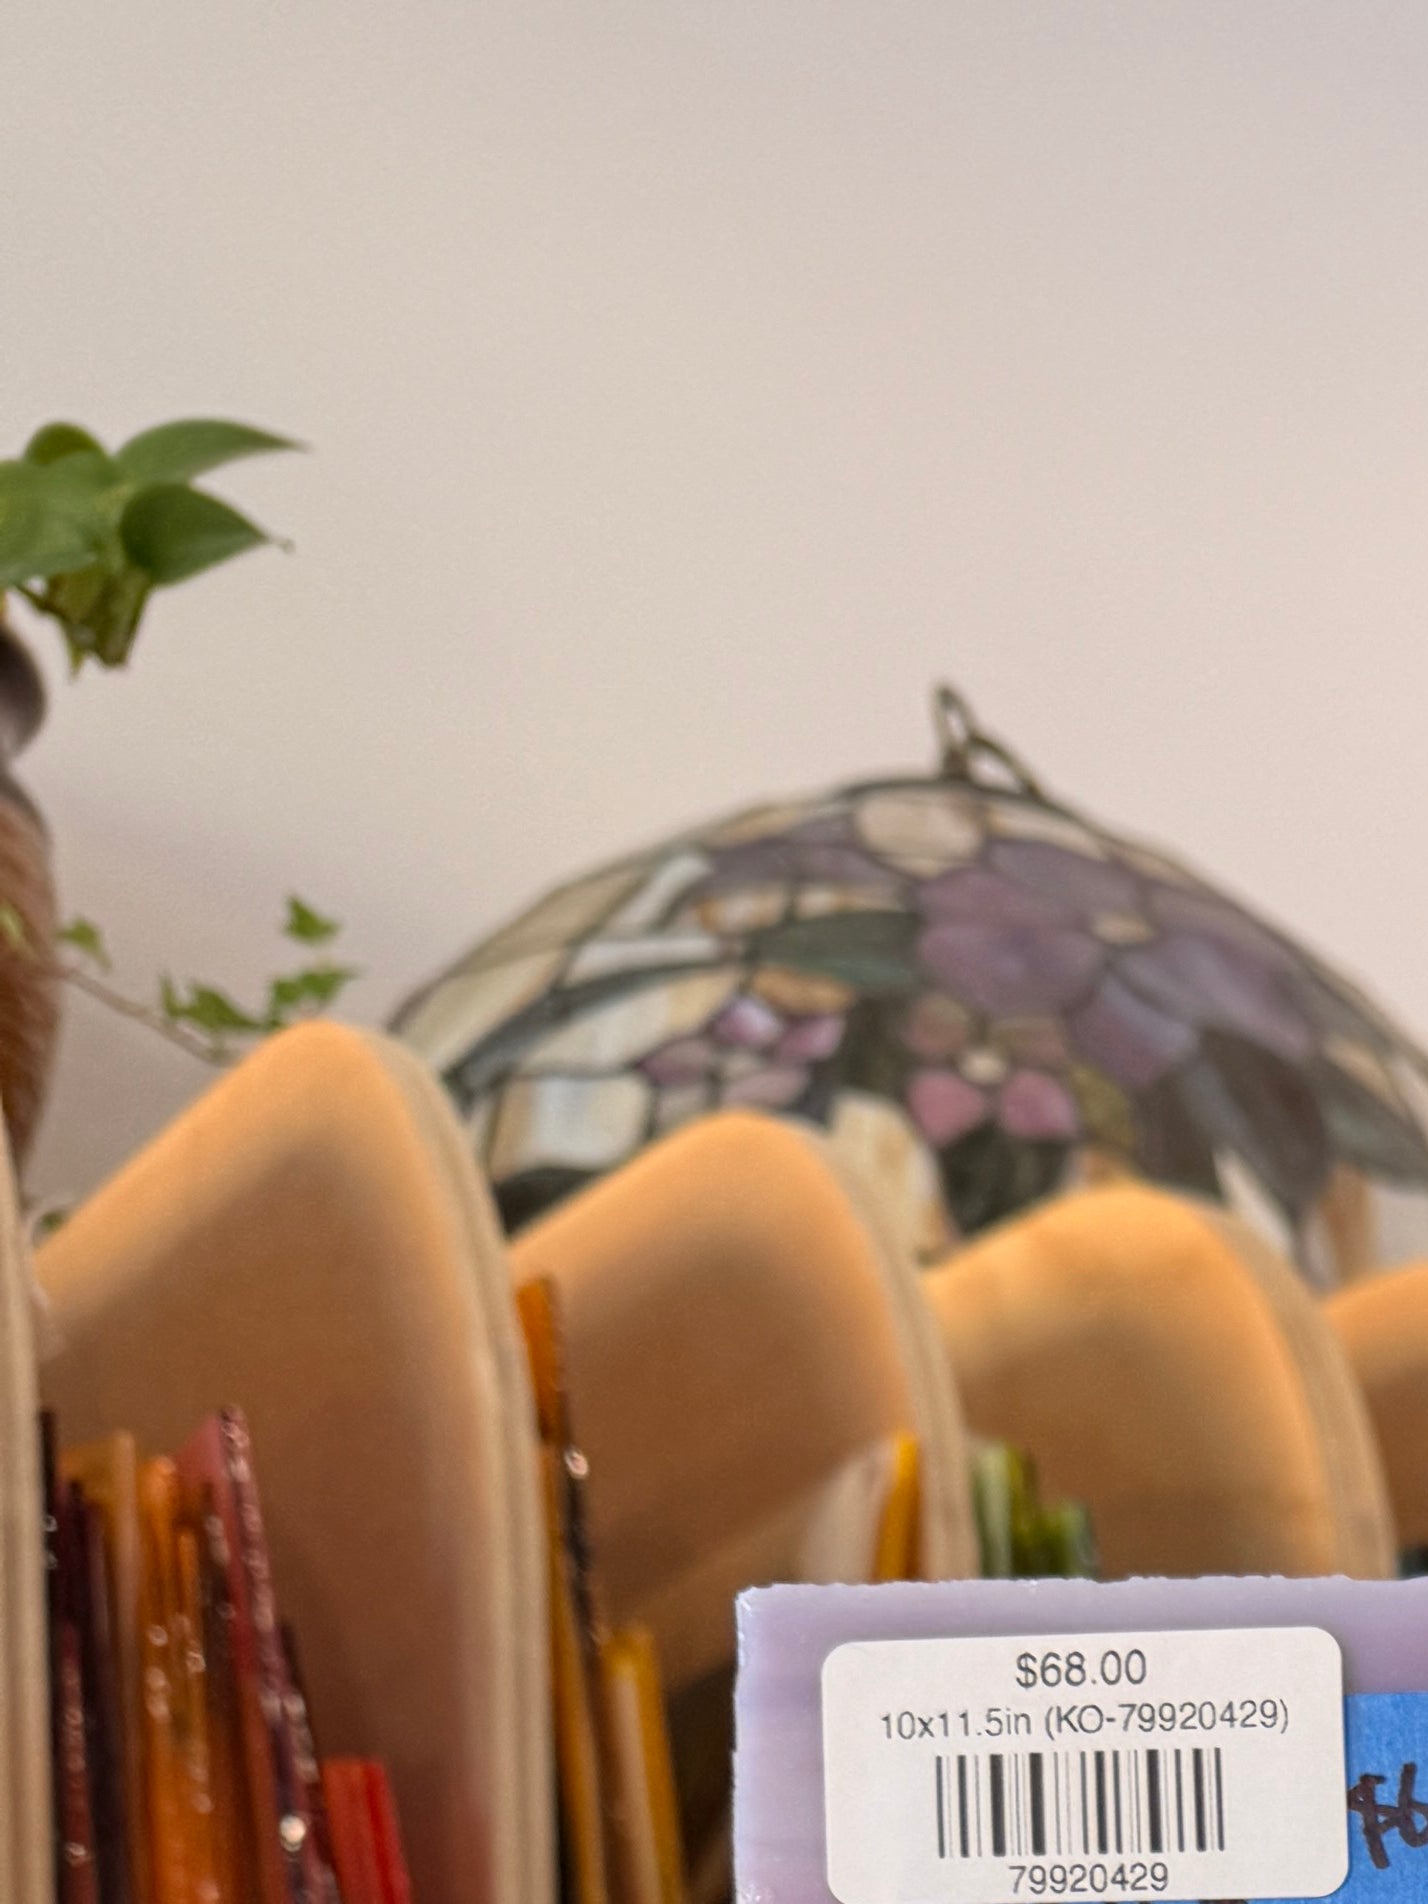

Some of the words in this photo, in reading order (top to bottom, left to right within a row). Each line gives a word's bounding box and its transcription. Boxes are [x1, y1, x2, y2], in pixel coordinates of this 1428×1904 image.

[1015, 1648, 1147, 1689] $68.00
[881, 1708, 1032, 1740] 10x11.5in
[1045, 1698, 1290, 1737] (KO-79920429)
[1009, 1862, 1169, 1895] 79920429
